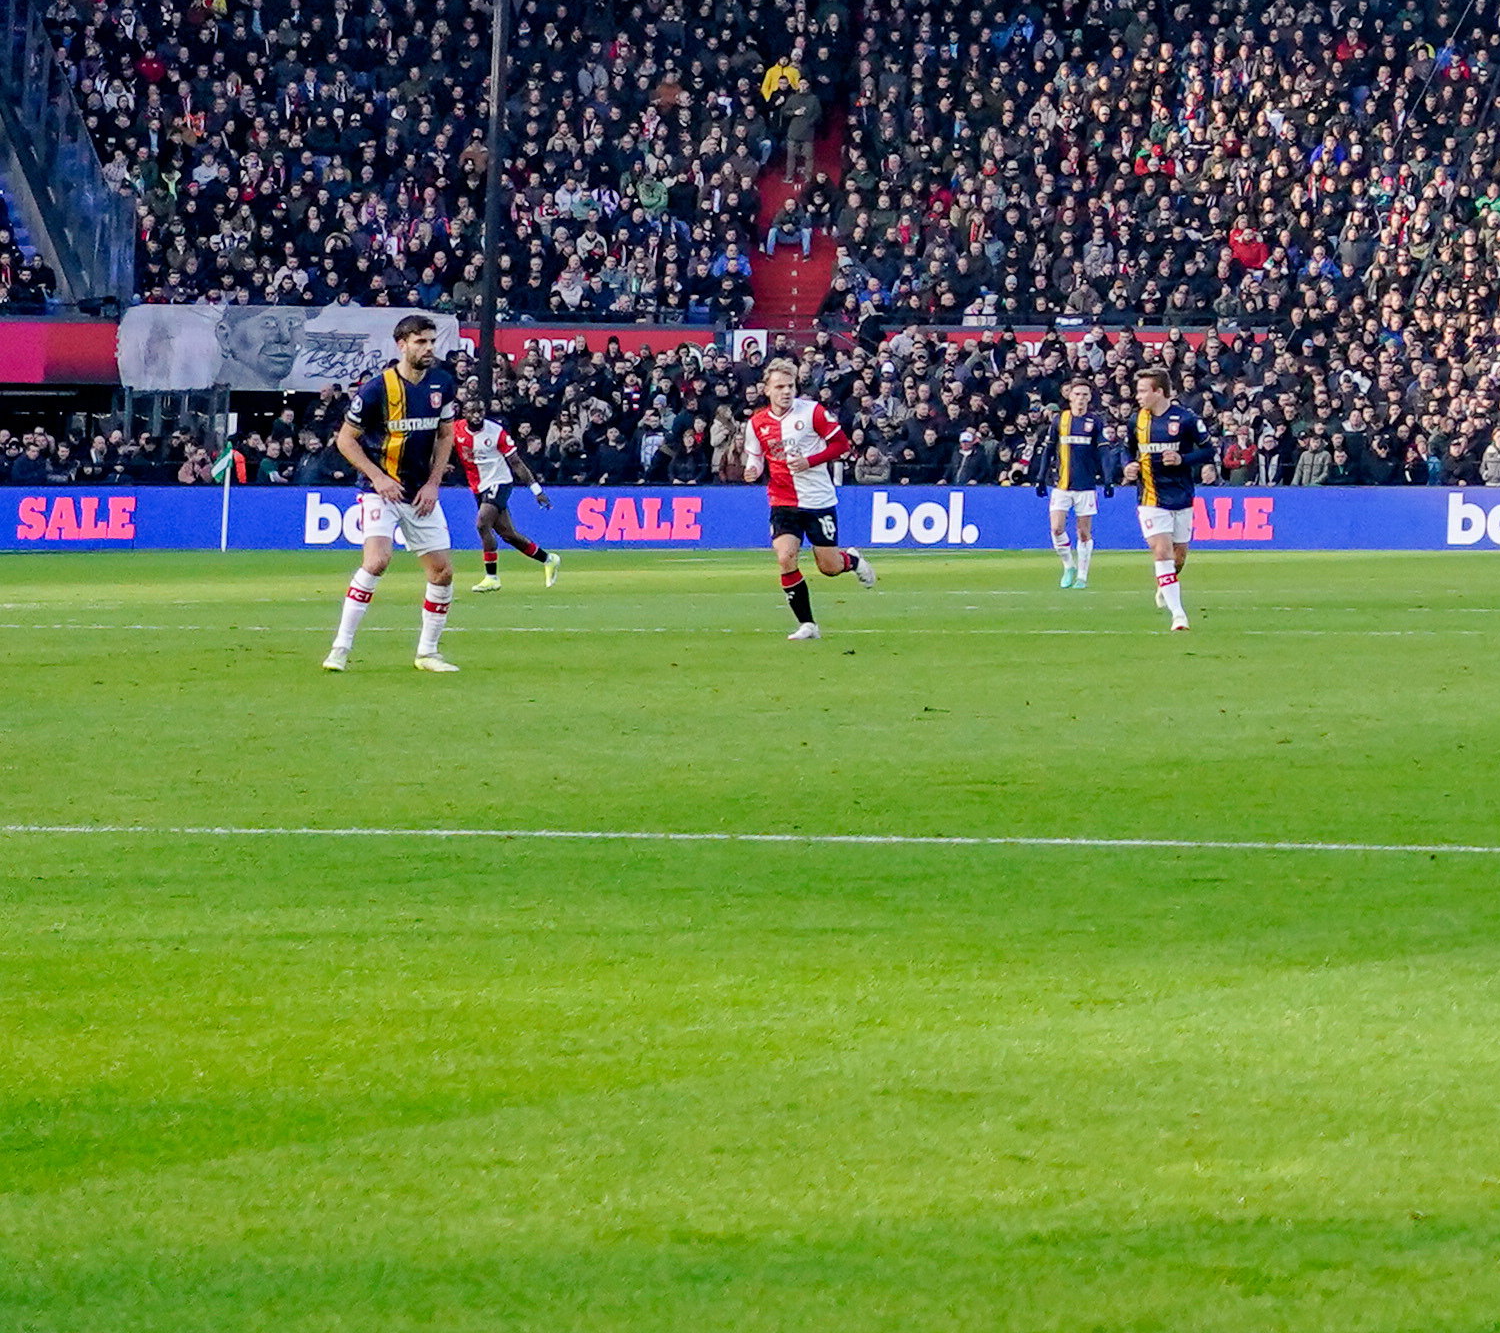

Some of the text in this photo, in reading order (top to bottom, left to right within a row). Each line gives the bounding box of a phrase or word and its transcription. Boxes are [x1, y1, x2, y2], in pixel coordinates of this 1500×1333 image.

[16, 496, 136, 540] SALE
[575, 497, 702, 541] SALE
[871, 491, 980, 544] bol.
[1192, 497, 1274, 541] ALE
